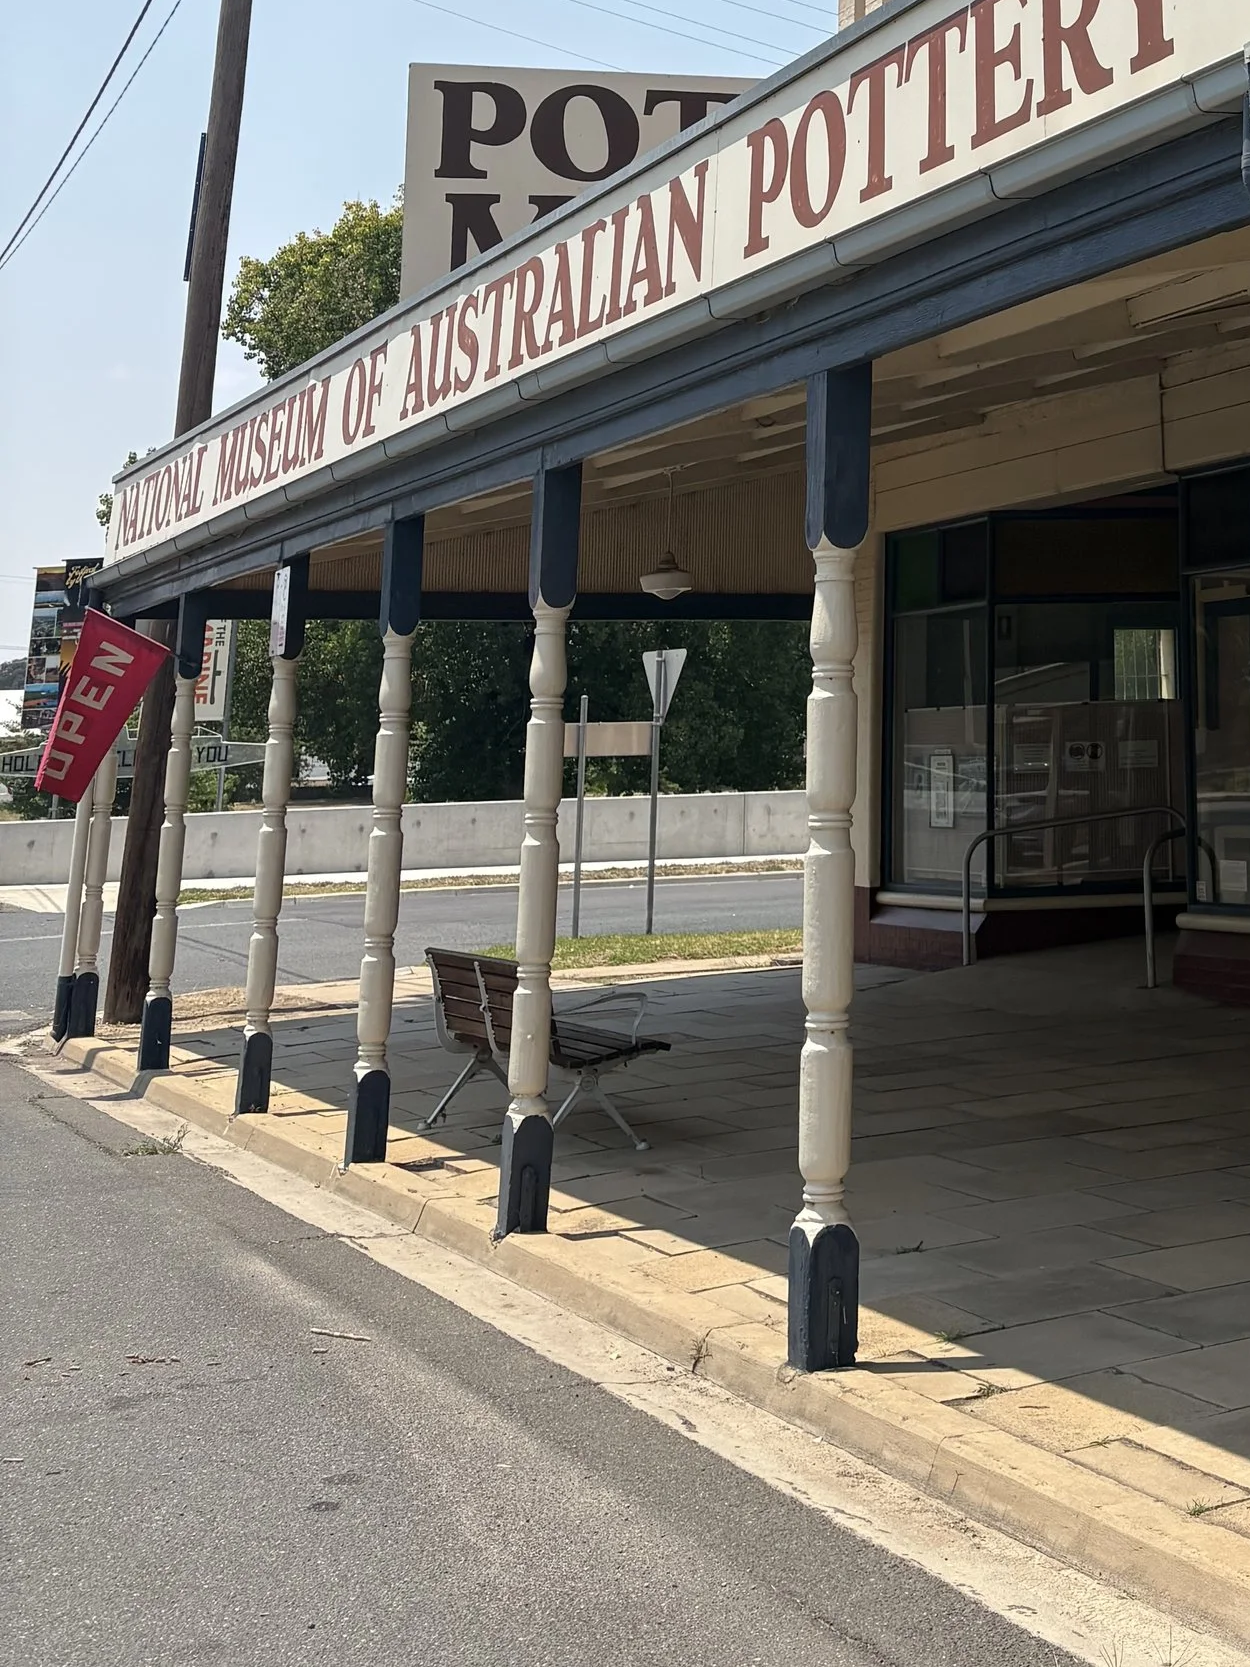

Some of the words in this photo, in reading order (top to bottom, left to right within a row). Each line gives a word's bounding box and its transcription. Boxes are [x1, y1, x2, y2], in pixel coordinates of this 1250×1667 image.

[114, 444, 208, 551] NATIONAL
[212, 375, 331, 507] MUSEUM
[341, 339, 389, 446] OF
[400, 158, 710, 421] AUSTRALIAN
[215, 625, 226, 647] THE
[44, 640, 135, 781] OPEN
[197, 746, 229, 763] YOU
